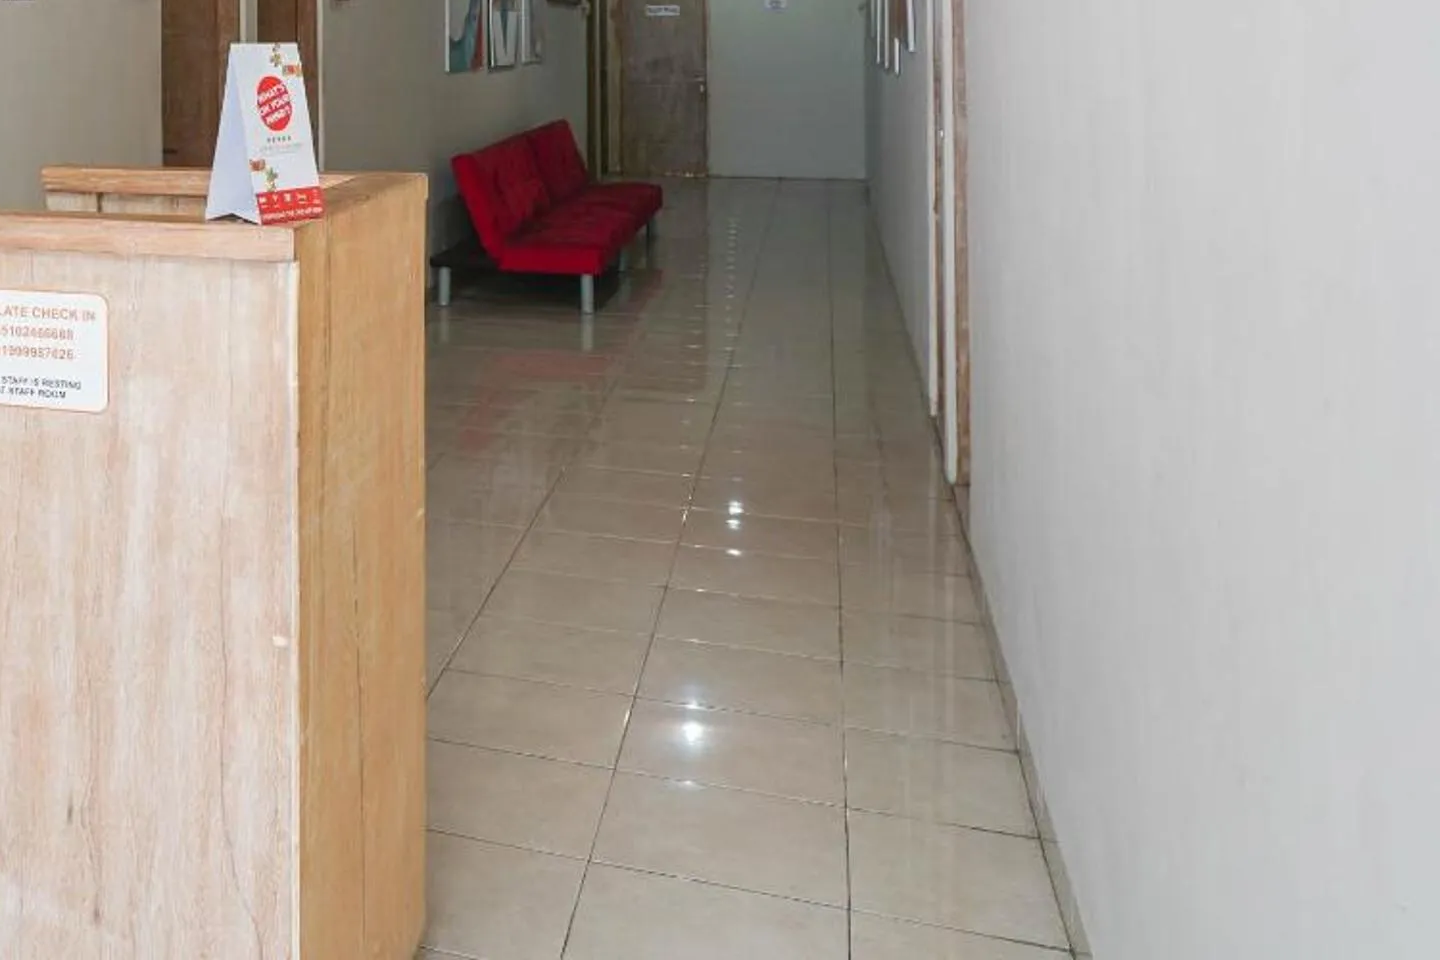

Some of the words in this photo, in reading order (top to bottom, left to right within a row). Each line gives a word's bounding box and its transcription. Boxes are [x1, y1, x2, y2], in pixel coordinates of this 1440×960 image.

[32, 306, 78, 321] CHECK
[82, 309, 96, 322] IN
[2, 375, 28, 385] STAFF
[30, 377, 39, 386] IS
[42, 378, 81, 390] RESTING
[9, 387, 35, 396] STAFF
[38, 388, 66, 399] ROOM
